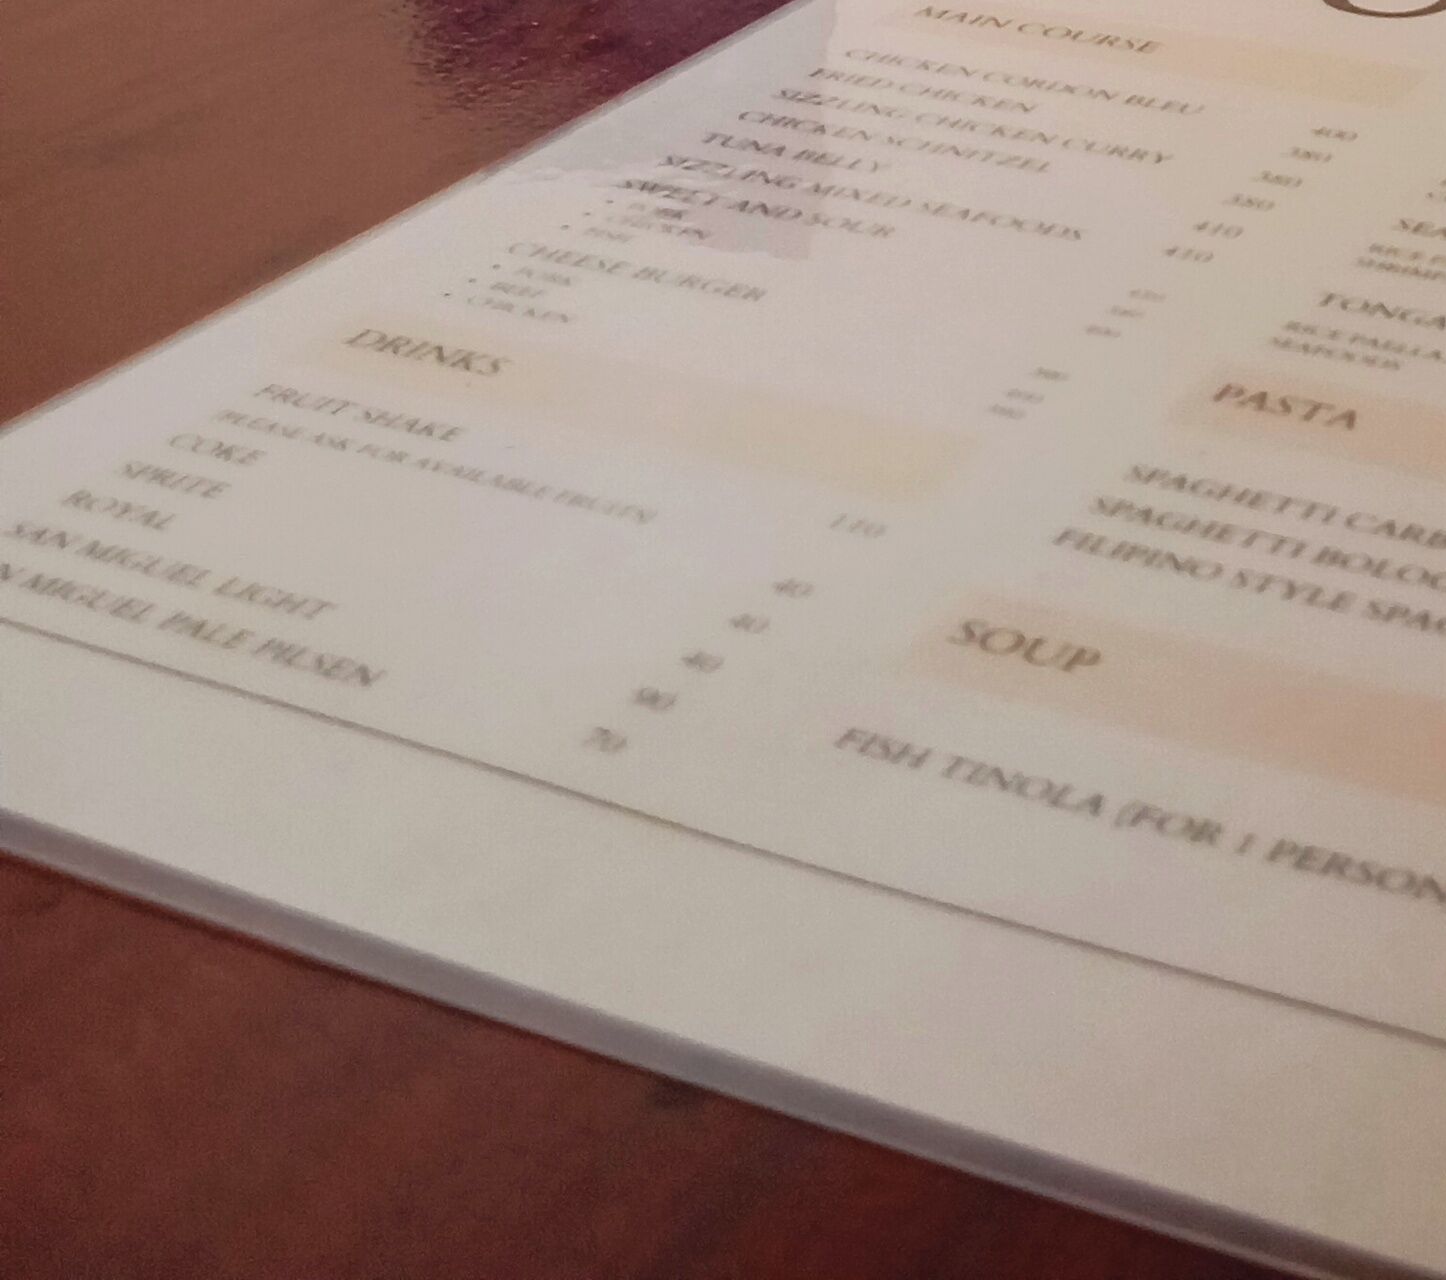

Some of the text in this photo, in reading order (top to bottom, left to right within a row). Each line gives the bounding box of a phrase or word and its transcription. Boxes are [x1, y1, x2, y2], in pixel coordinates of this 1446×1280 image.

[918, 6, 1160, 53] MAIN COURSE
[806, 67, 890, 88] FRIED
[896, 84, 1039, 114] CHICKEN
[841, 49, 980, 78] CHICKEN
[1121, 94, 1206, 116] BLEU
[699, 132, 791, 157] TUNA
[735, 110, 875, 142] CHICKEN
[912, 114, 1060, 145] CHICKEN
[1058, 138, 1174, 165] CURRY
[730, 199, 805, 220] AND
[503, 243, 770, 302] CHEESE BURGER
[343, 329, 508, 375] DRINKS
[251, 383, 359, 416] FRUIT
[356, 408, 465, 442] SHAKE
[1210, 383, 1363, 431] PASTA
[165, 434, 265, 466] COKE
[116, 462, 230, 499] SPRITE
[1125, 464, 1341, 525] SPAGHETTI
[58, 489, 180, 531] ROYAL
[1090, 496, 1311, 559] SPAGHETTI
[8, 523, 76, 550] SAN
[70, 539, 216, 589] MIGUEL
[210, 577, 338, 621] LIGHT
[1050, 528, 1227, 581] FILIPINO
[1230, 569, 1357, 613] STYLE
[15, 572, 162, 624] MIGUEL
[154, 612, 255, 651] PALE
[248, 638, 386, 688] PILSEN
[953, 619, 1106, 675] SOUP
[831, 727, 935, 770] FISH
[938, 755, 1110, 819] TINOLA
[1112, 802, 1226, 848] (FOR
